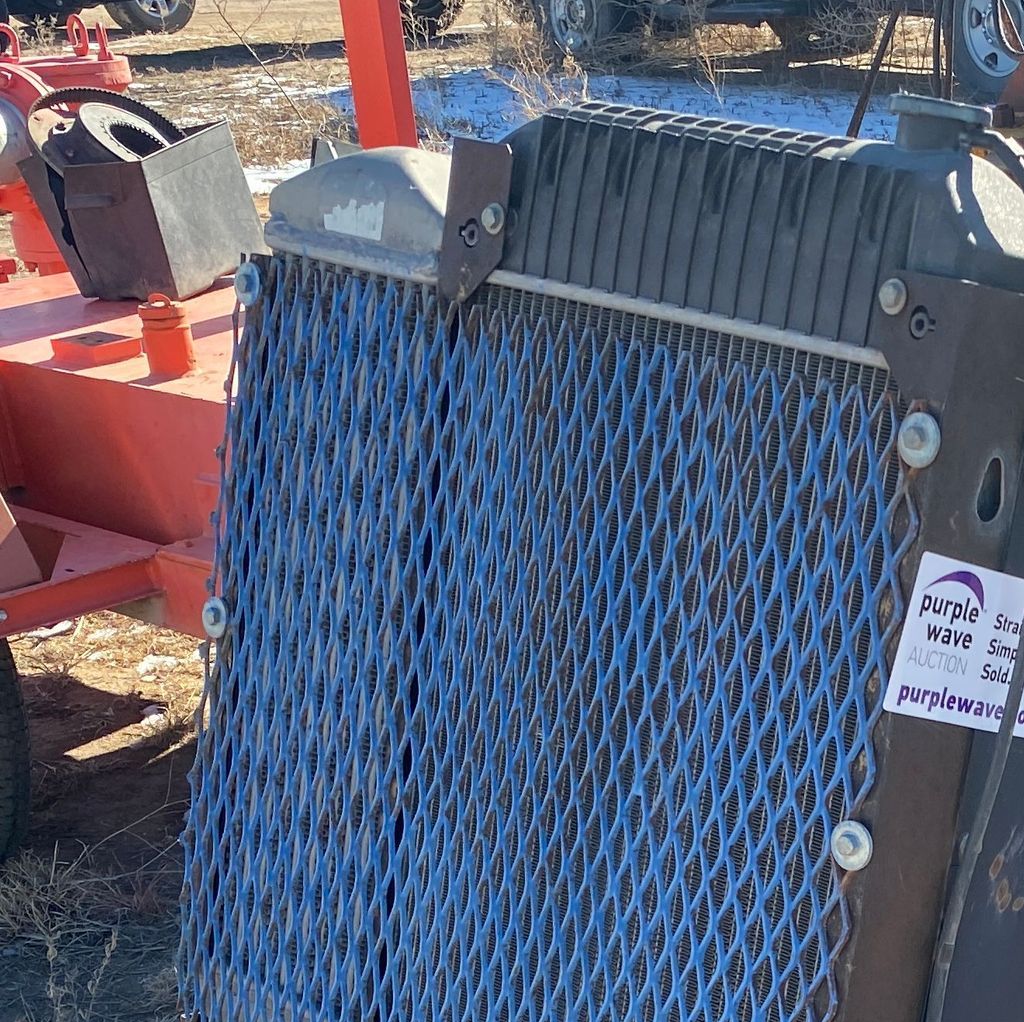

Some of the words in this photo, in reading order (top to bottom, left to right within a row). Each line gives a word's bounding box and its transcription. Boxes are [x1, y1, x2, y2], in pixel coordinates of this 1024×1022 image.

[919, 593, 979, 624] purple
[927, 623, 973, 649] wave
[908, 647, 968, 675] AUCTION
[980, 663, 1012, 685] Sold.
